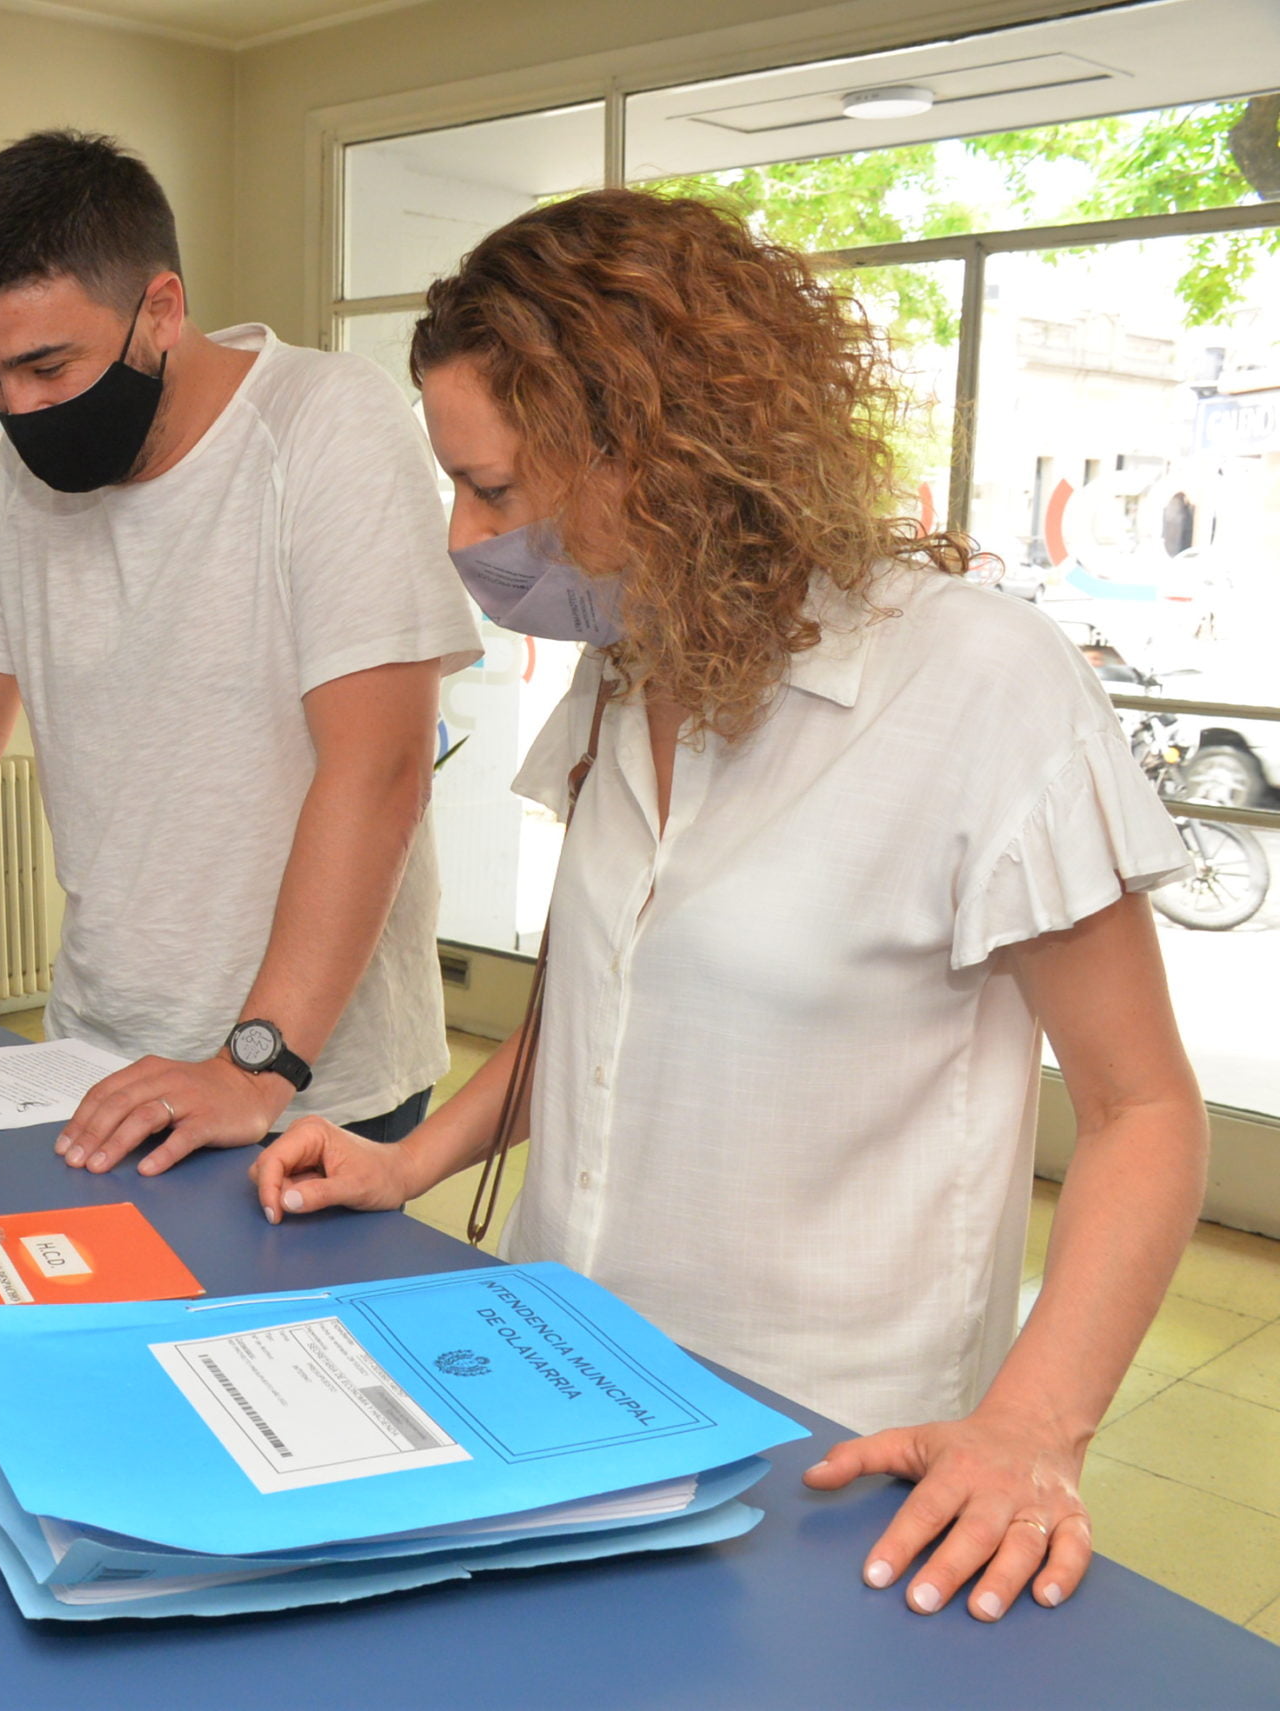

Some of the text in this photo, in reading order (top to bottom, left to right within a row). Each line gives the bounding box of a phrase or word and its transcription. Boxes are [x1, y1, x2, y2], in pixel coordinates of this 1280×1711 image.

[476, 1308, 583, 1401] DE OLAVARRIA
[478, 1280, 656, 1427] INTENDENCIA MUNICIPAL
